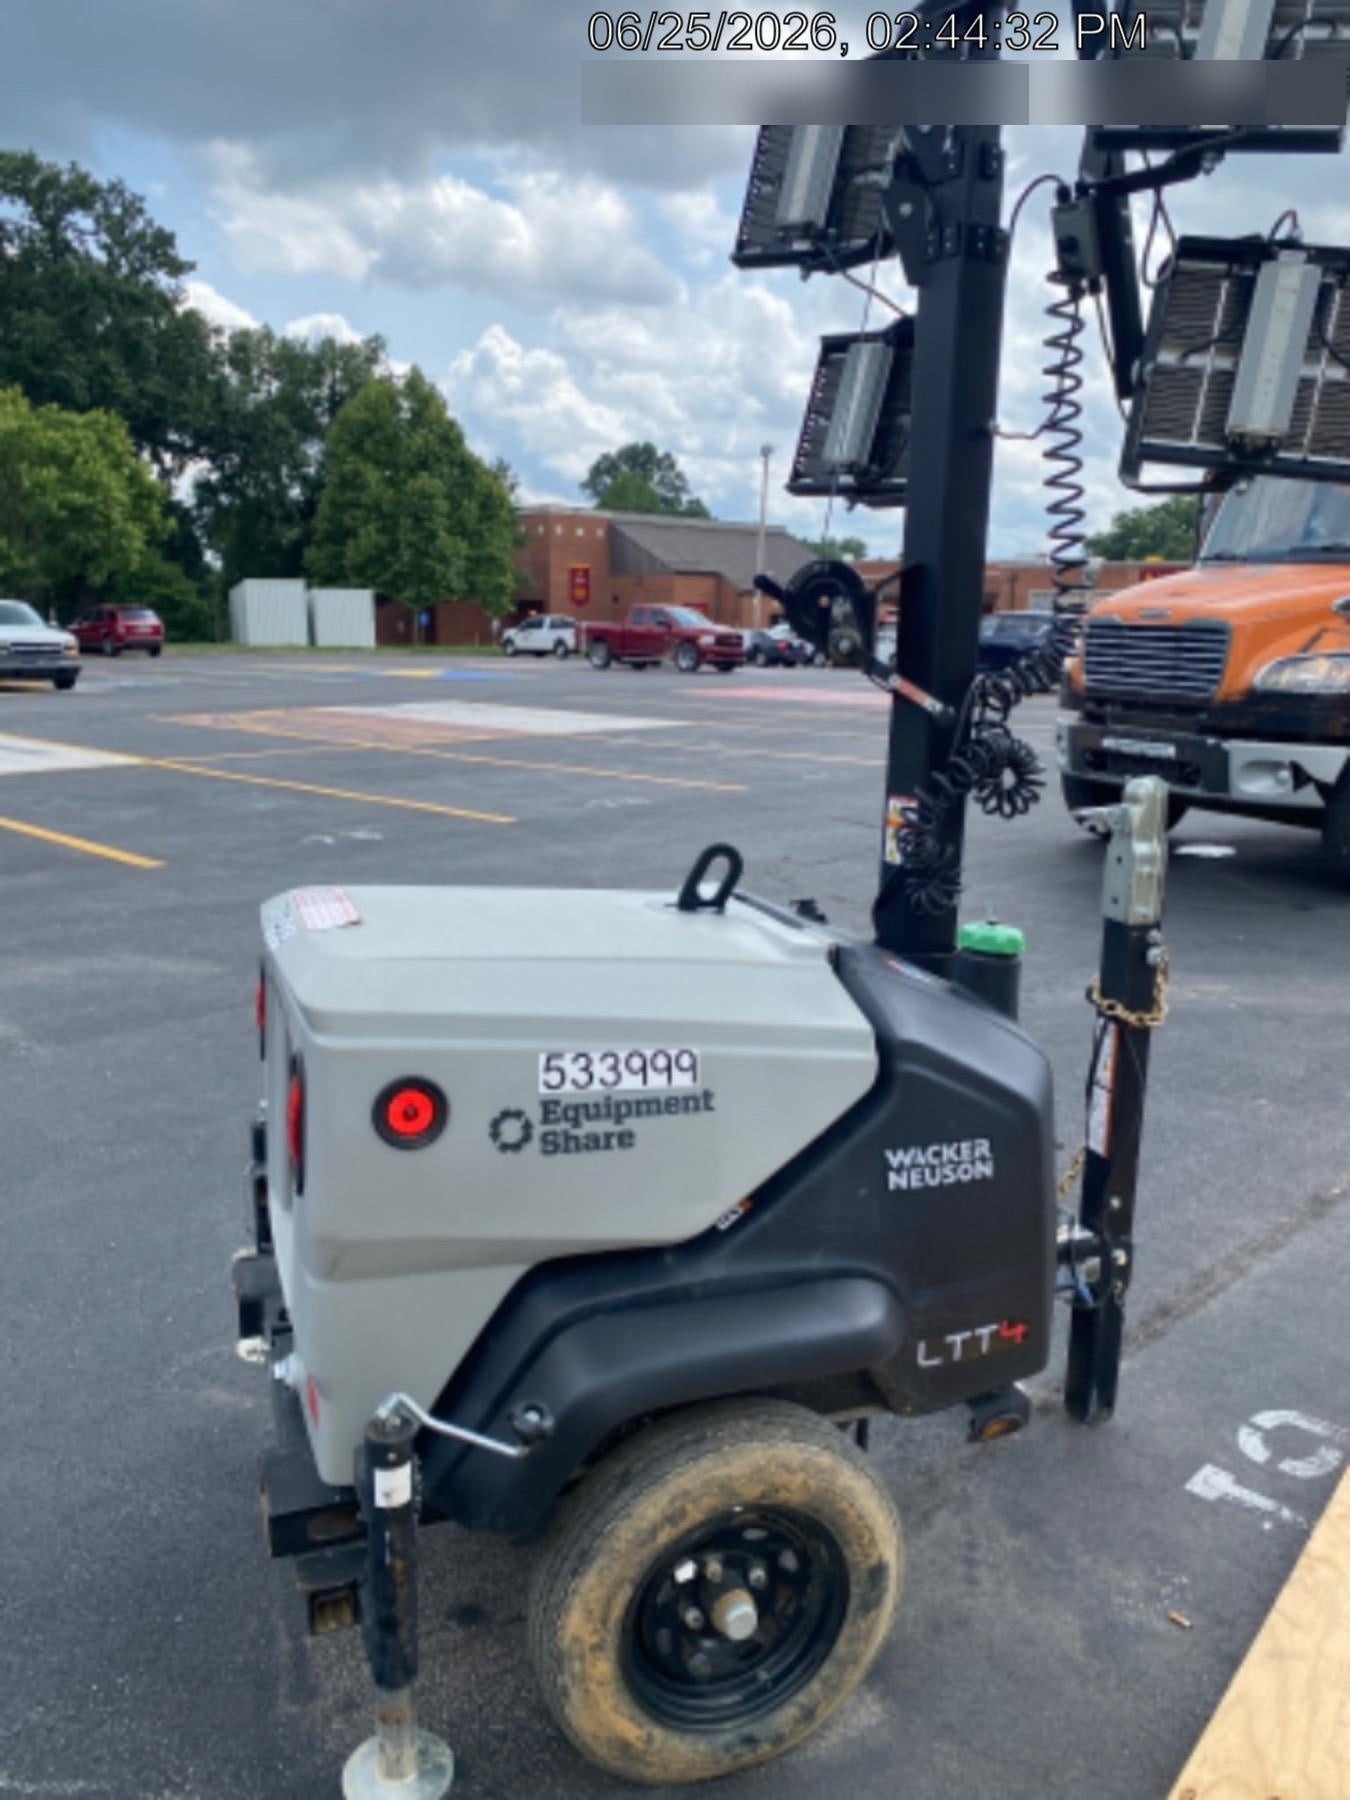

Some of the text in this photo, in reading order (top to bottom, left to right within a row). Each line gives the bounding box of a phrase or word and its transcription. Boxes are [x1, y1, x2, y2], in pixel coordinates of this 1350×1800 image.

[542, 1049, 698, 1091] 533999
[540, 1089, 715, 1128] Equipment
[540, 1128, 636, 1154] Share
[888, 1160, 994, 1191] NEUSON
[917, 1321, 1028, 1367] LTT4
